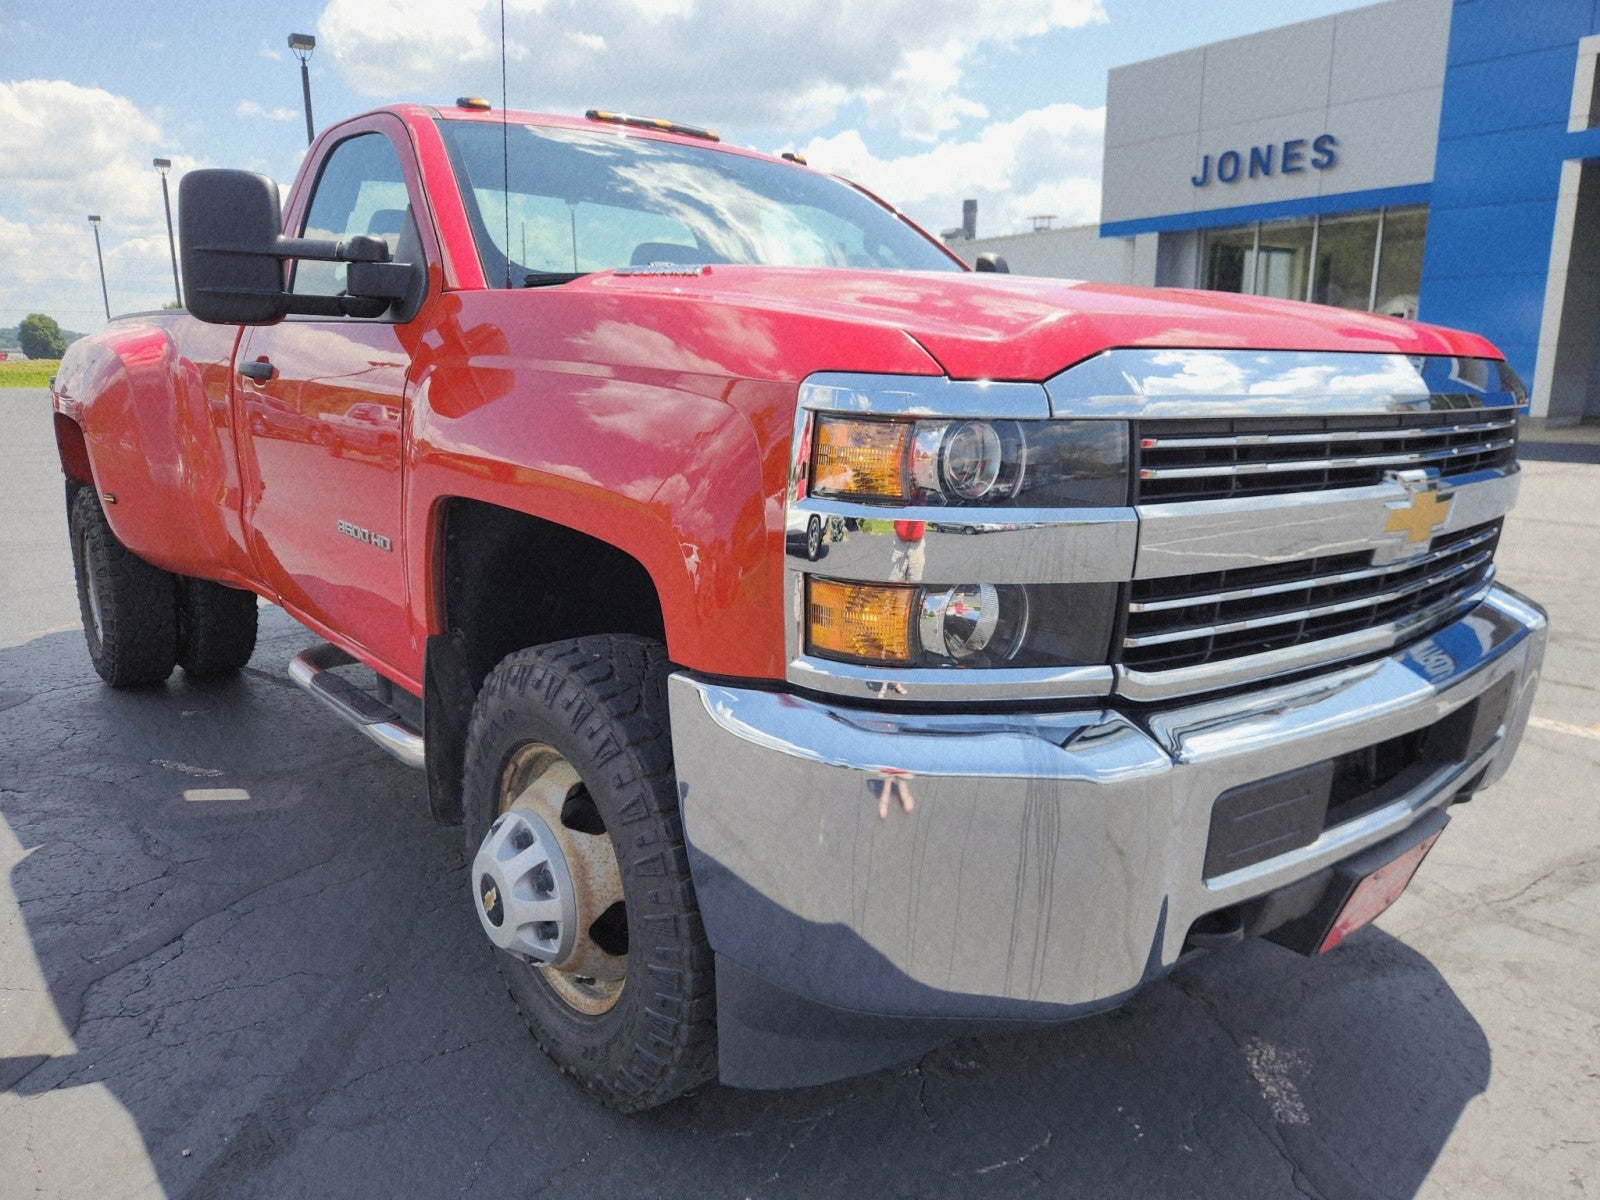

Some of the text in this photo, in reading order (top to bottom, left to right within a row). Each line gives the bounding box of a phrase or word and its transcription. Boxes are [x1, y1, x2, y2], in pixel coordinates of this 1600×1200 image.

[1191, 134, 1337, 188] JONES
[337, 519, 392, 552] 3500 HD
